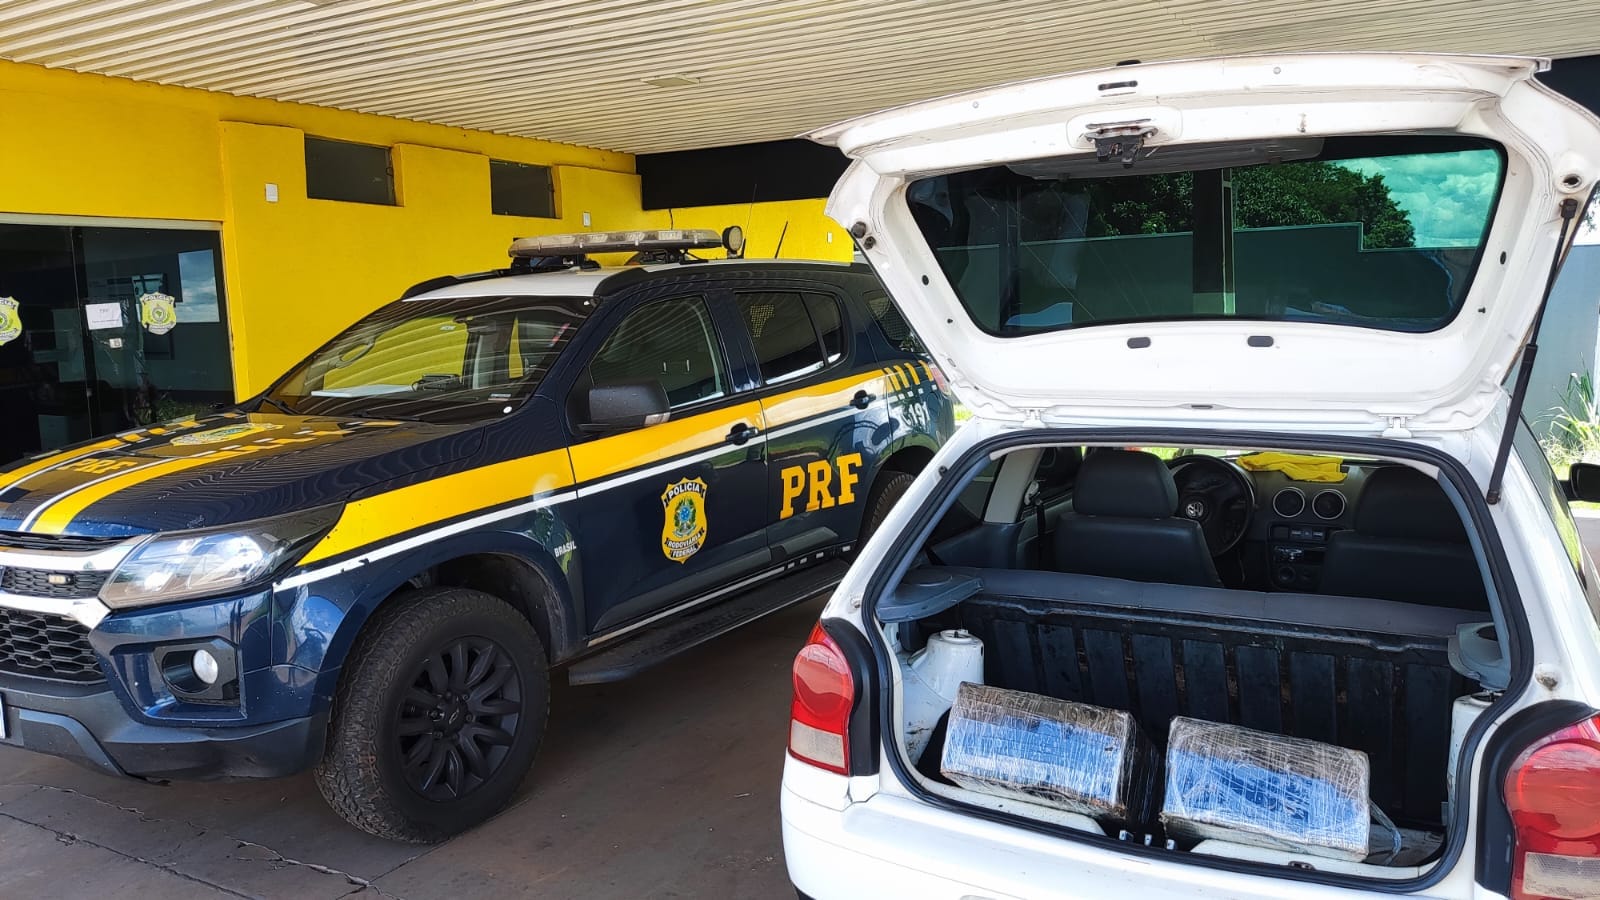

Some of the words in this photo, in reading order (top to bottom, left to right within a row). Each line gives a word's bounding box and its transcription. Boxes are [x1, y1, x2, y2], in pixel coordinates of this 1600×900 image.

[56, 458, 138, 474] PRF
[780, 453, 862, 519] PRF
[554, 541, 577, 558] BRASIL
[672, 545, 697, 558] FEDERAL
